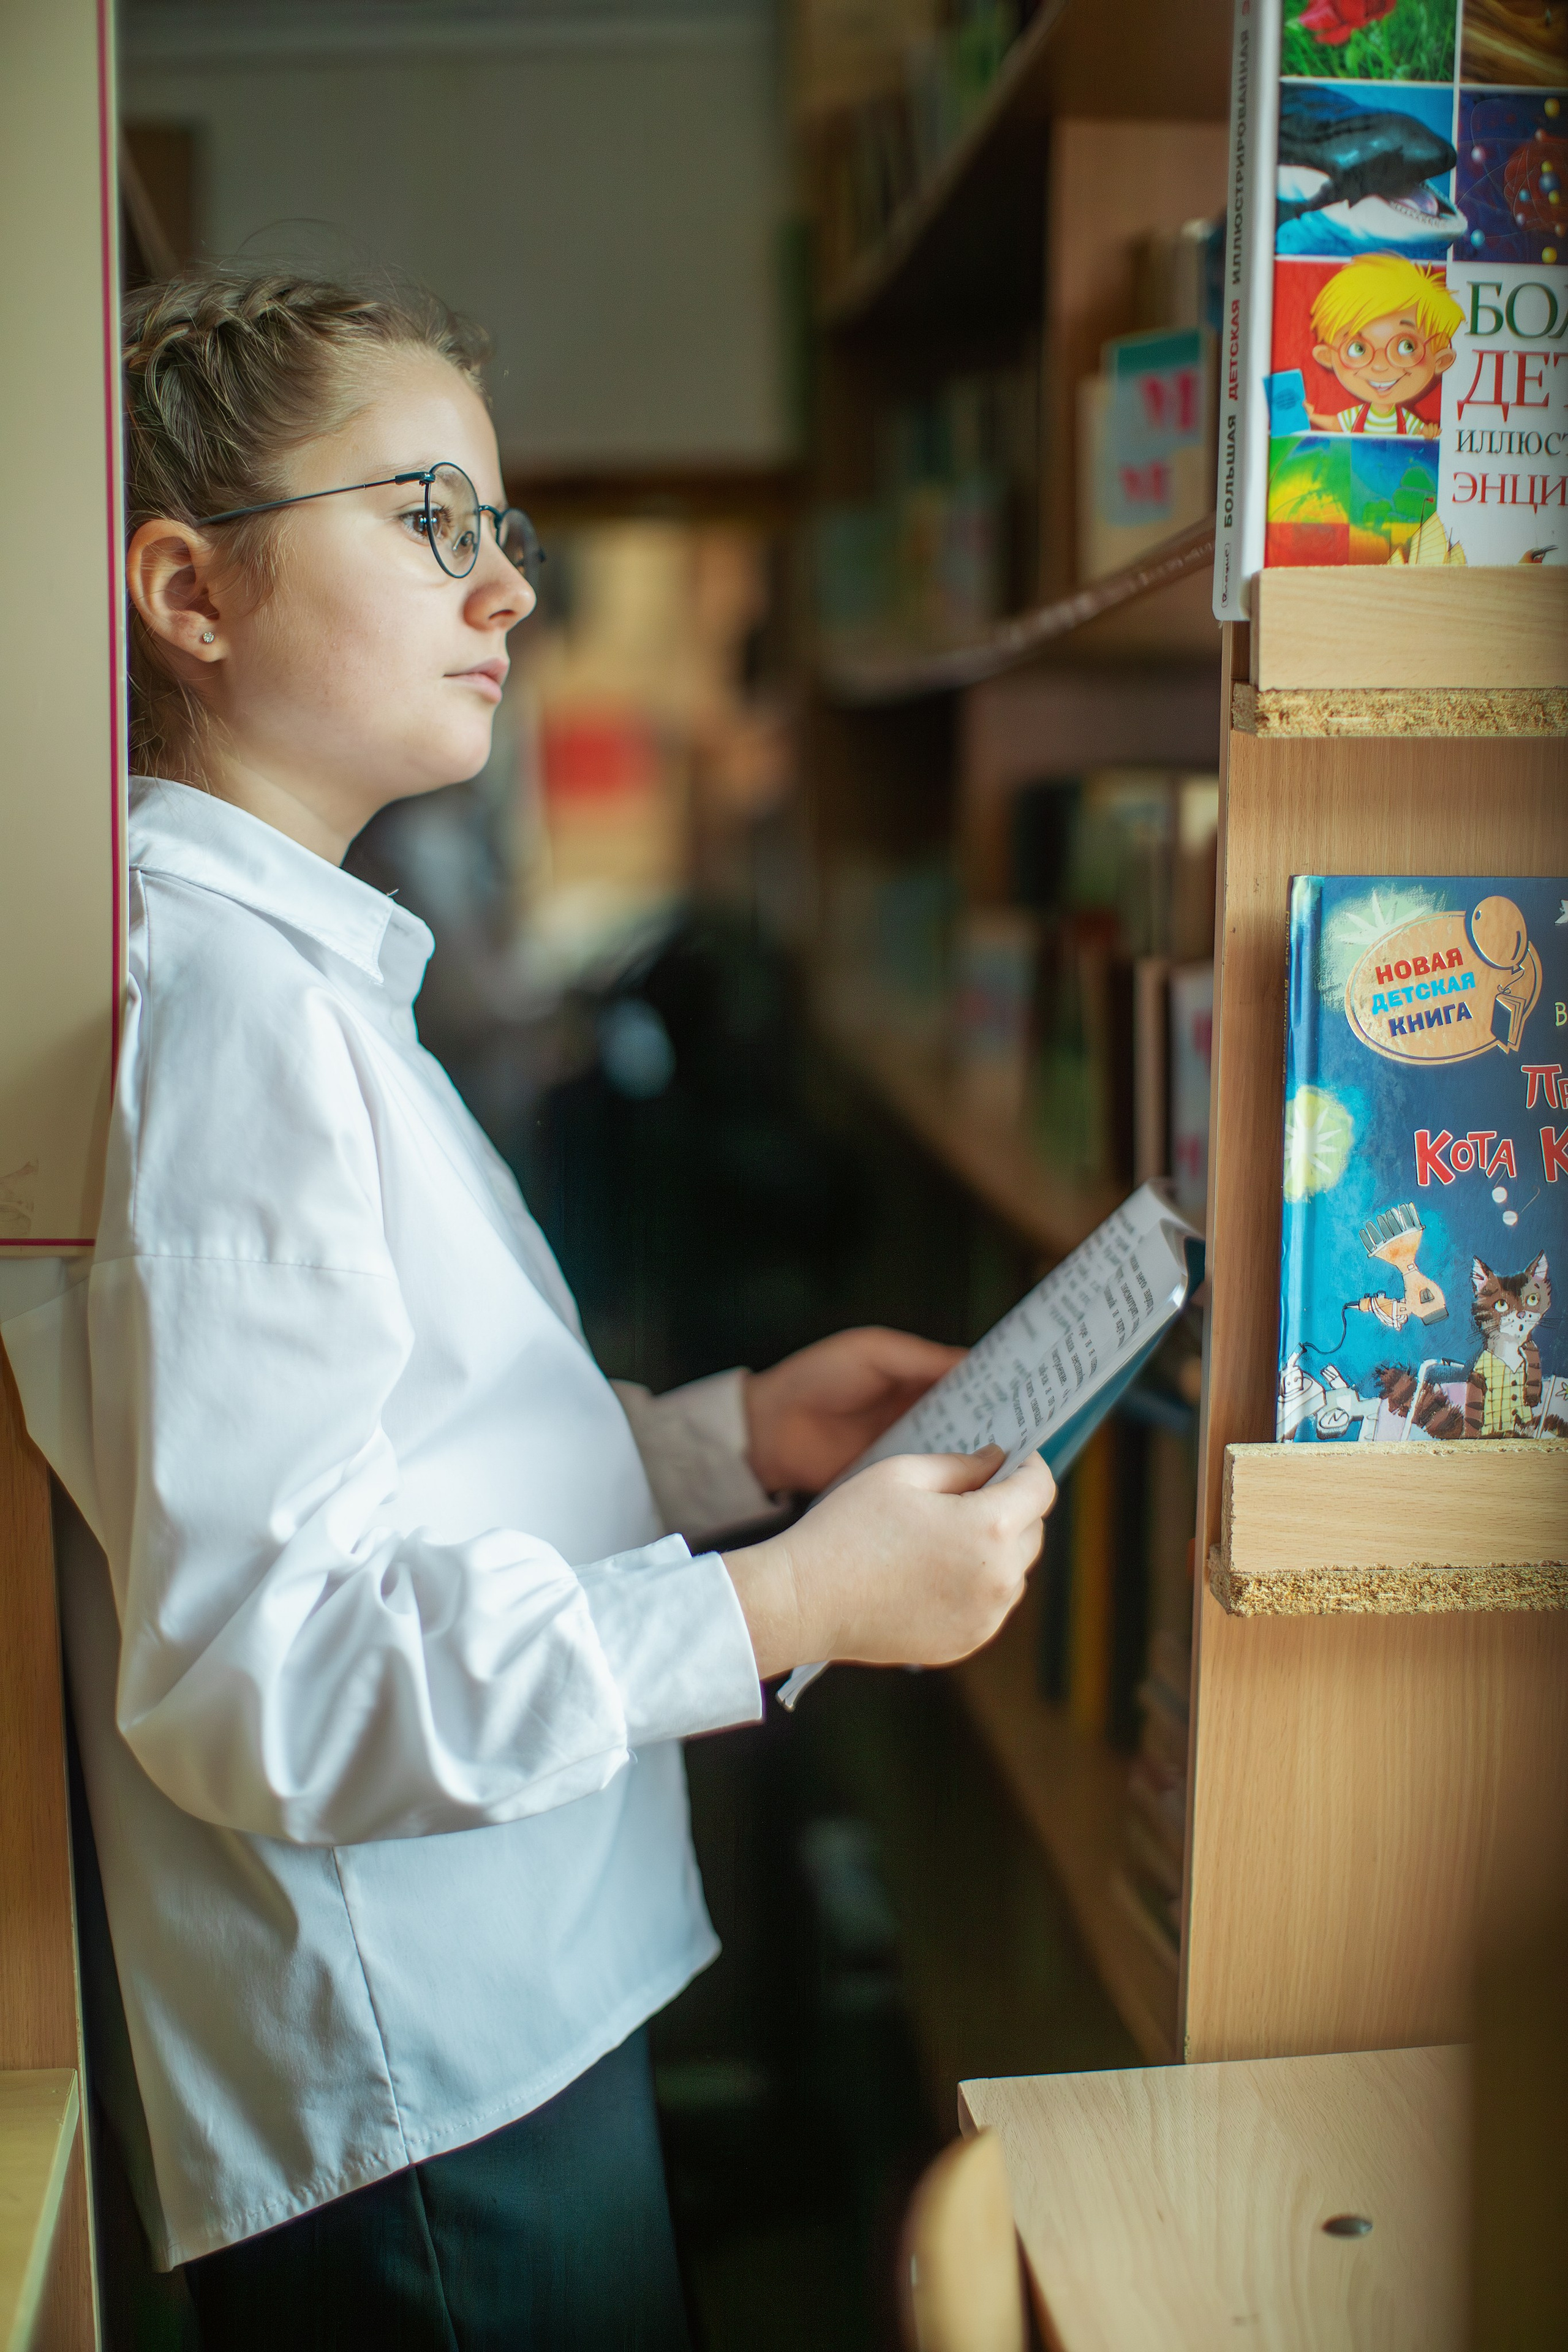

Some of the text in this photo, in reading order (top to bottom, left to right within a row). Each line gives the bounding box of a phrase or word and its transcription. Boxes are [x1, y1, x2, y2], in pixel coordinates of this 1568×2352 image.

[1232, 28, 1250, 285] ИЛЛЮСТРИРОВАННАЯ
[1227, 299, 1240, 401] ДЕТСКАЯ
[1224, 414, 1237, 529] БОЛЬШАЯ
[1371, 971, 1476, 1015] ДЕТСКАЯ
[1375, 946, 1463, 985] НОВАЯ
[1388, 1001, 1472, 1037] КНИГА
